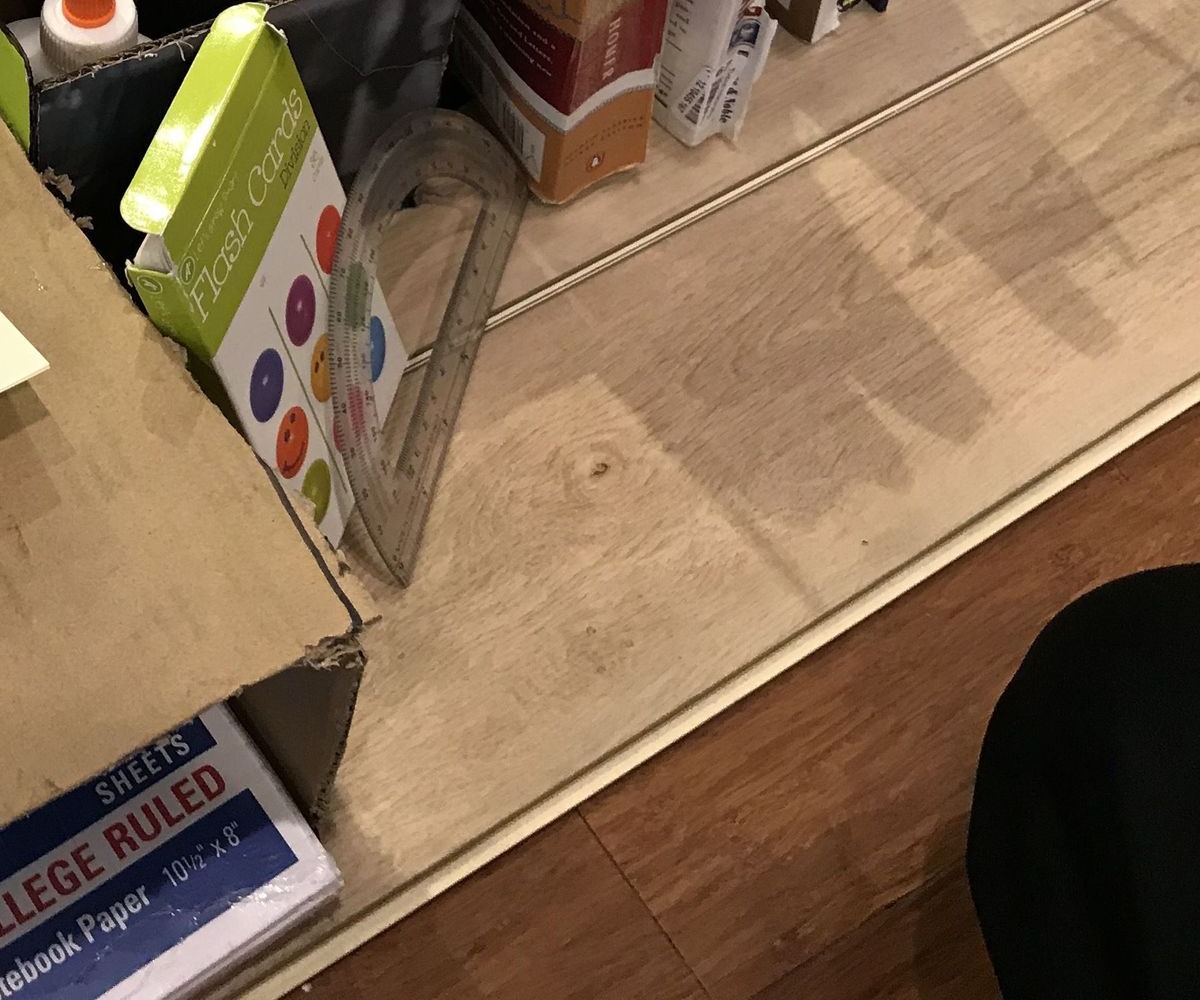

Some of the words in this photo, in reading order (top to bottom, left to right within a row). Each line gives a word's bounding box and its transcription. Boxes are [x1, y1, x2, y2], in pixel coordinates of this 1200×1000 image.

[278, 119, 311, 190] Division
[189, 206, 254, 323] Flash
[247, 87, 303, 207] Cards
[95, 732, 192, 806] SHEETS
[102, 763, 227, 862] RULED
[75, 884, 152, 945] Paper
